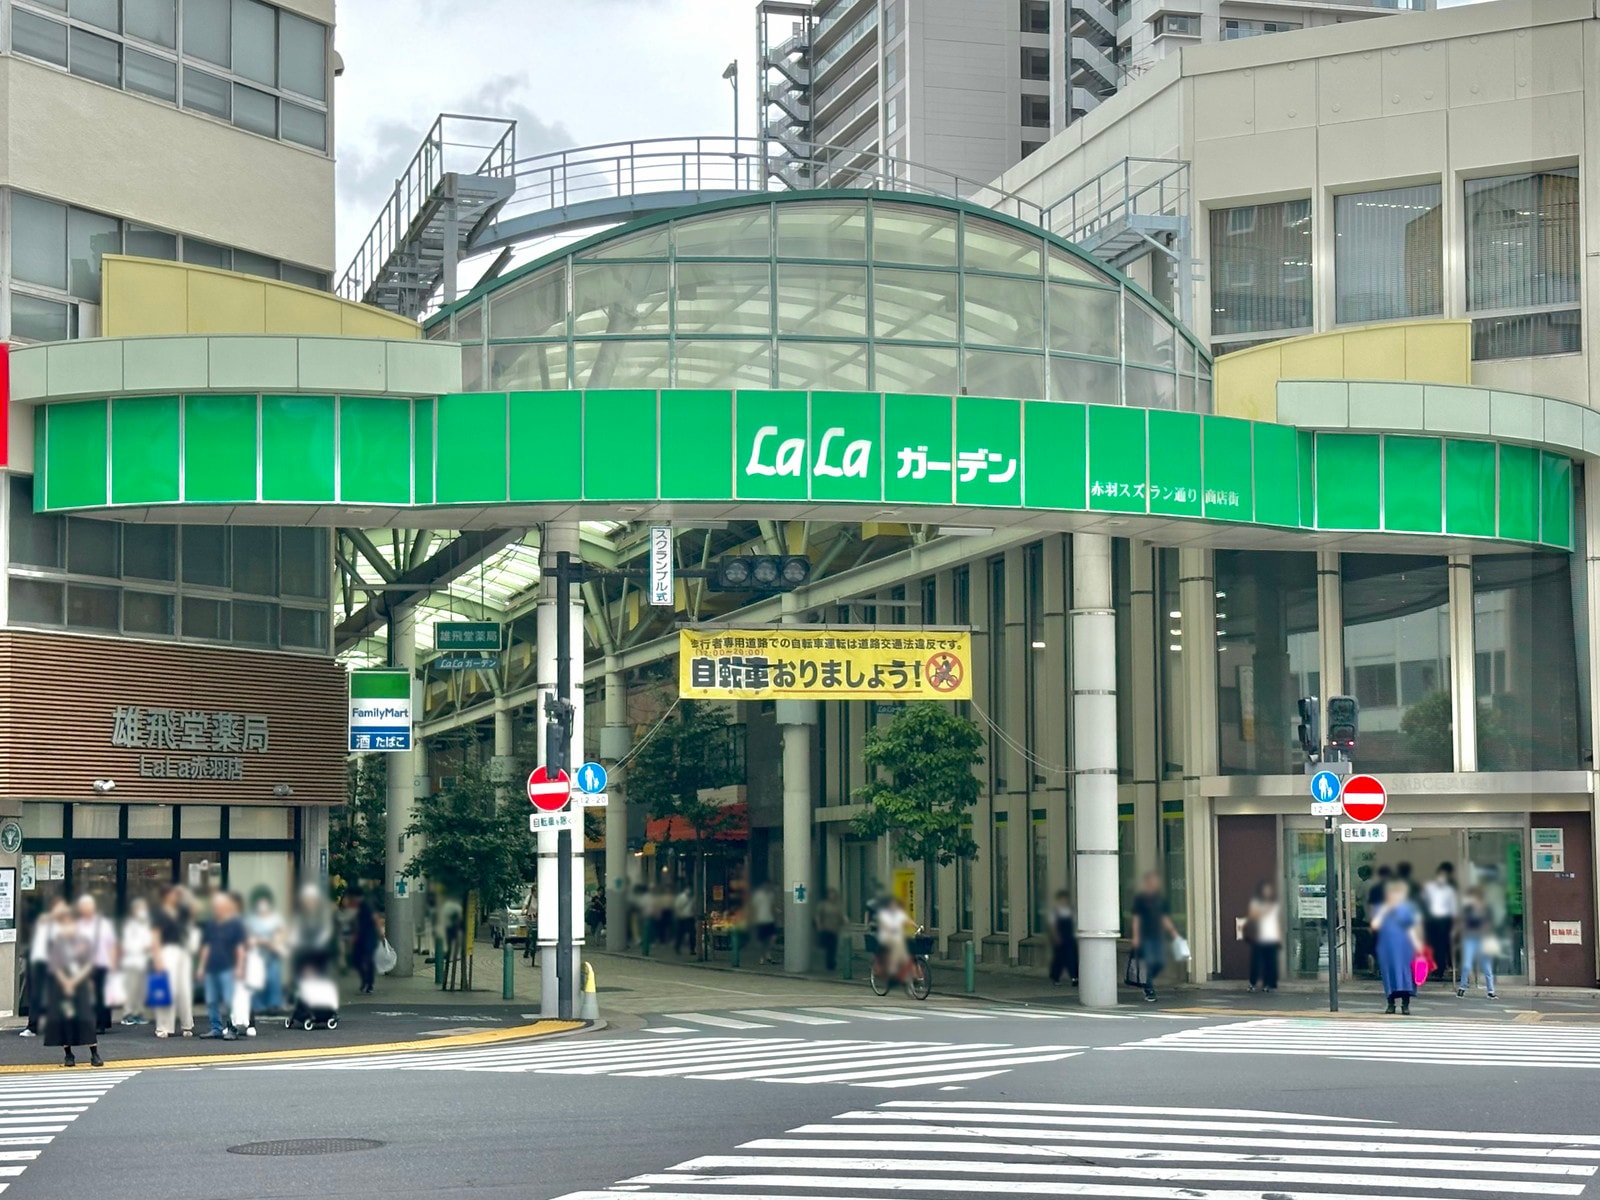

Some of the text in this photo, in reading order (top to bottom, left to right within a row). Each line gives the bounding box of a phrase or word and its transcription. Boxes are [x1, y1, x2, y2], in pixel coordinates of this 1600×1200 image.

[897, 446, 1016, 483] ガーデン
[352, 707, 409, 720] FamilyMart
[112, 705, 269, 754] 雄飛堂薬局
[356, 734, 405, 749] 酒 たばこ
